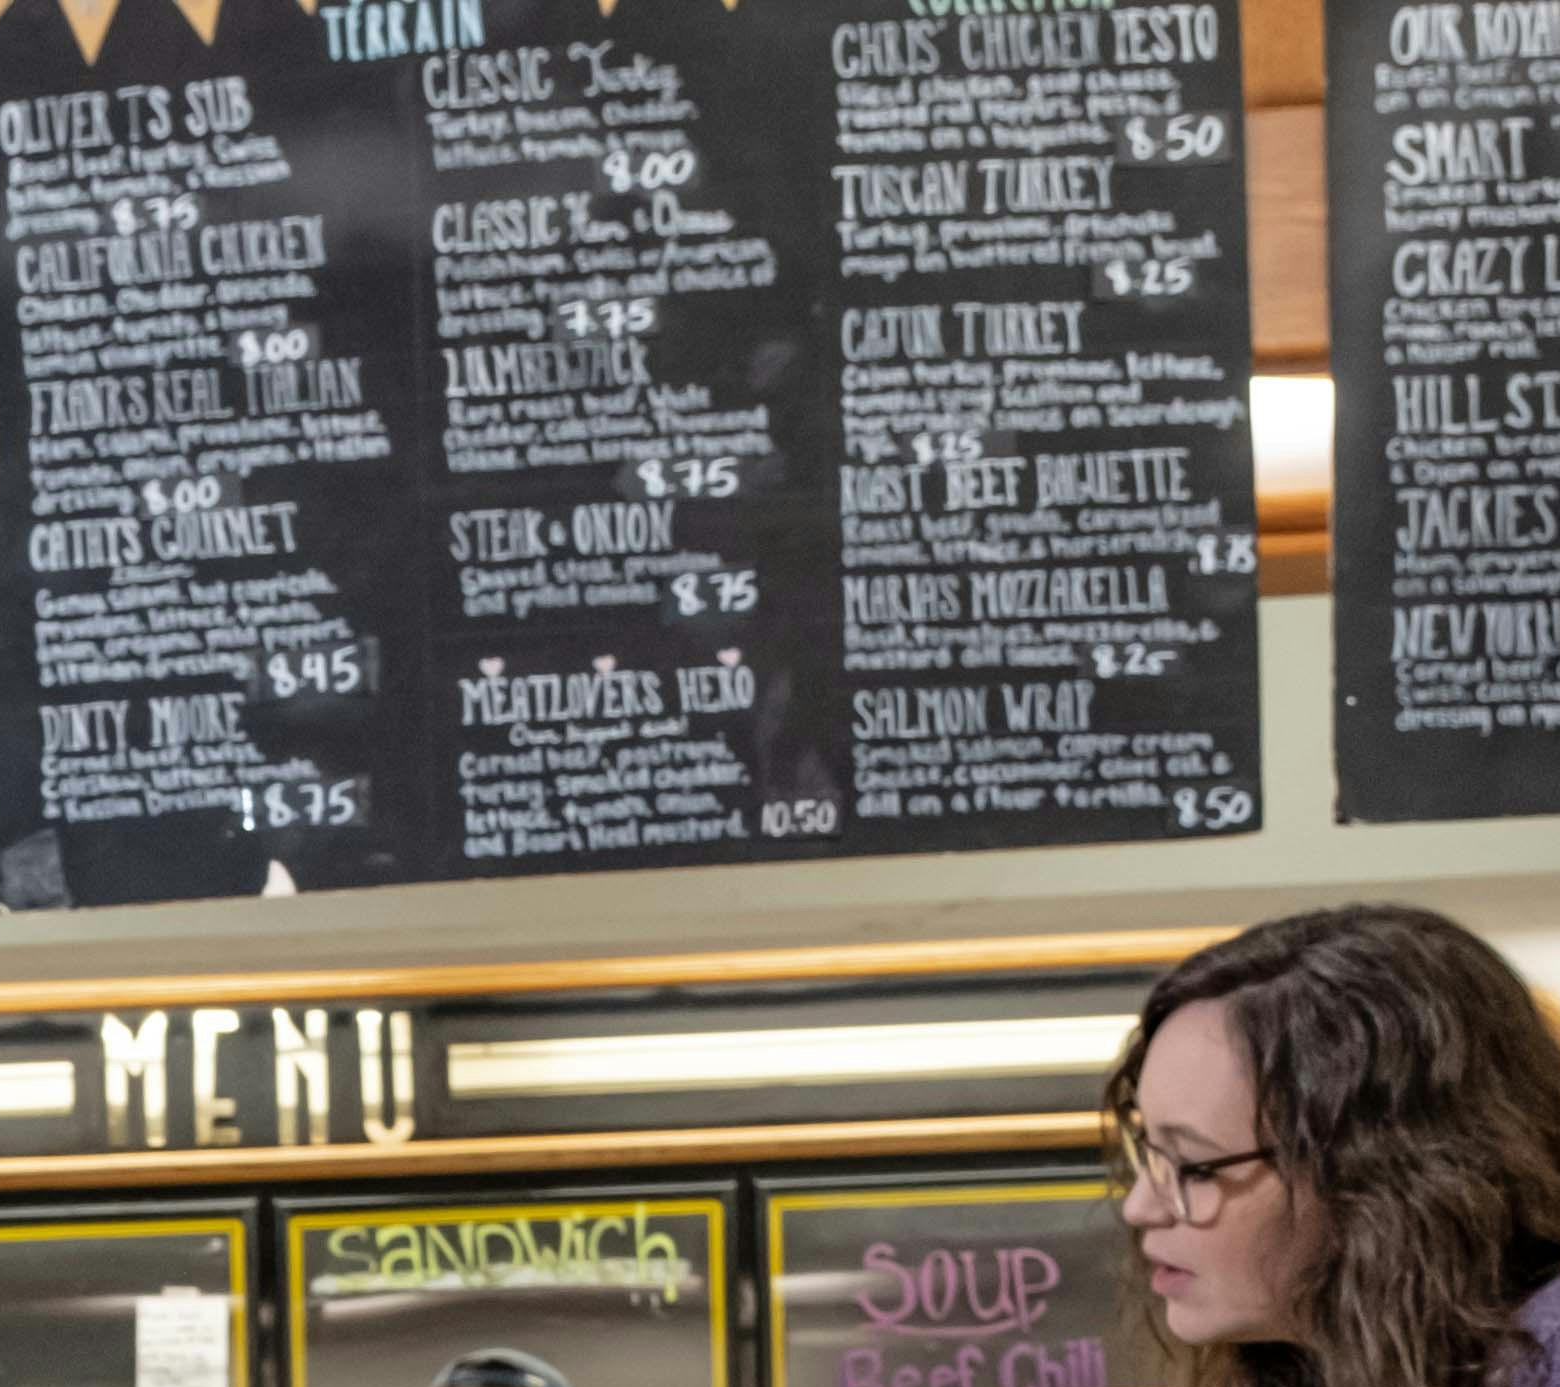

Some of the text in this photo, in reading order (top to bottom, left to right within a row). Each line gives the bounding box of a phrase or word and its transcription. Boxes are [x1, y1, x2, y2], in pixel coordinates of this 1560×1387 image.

[959, 5, 1219, 72] CHICKEN PESTO
[1389, 6, 1466, 66] OUR
[184, 76, 254, 137] SUB
[421, 46, 555, 110] CLASSIC
[1385, 118, 1534, 186] SMART
[830, 156, 1115, 220] TUSCAN TURKEY
[17, 214, 327, 294] CALIFORNIA CHICKEN
[432, 195, 561, 256] CLASSIC
[1393, 235, 1535, 298] CRAZY
[840, 300, 1086, 363] CAJUN TURKEY
[442, 337, 651, 398] LUMBERJACK
[1392, 373, 1499, 436] HILL
[637, 456, 740, 498] 8.75
[839, 464, 923, 515] ROAST
[449, 500, 676, 562] STEAK ONION
[970, 565, 1170, 620] MOZZARELLA
[1390, 603, 1479, 661] NEW
[266, 645, 361, 699] 8.45
[458, 666, 755, 726] MEATLOVERS HERO
[148, 692, 248, 748] MOORE
[851, 678, 1095, 740] SALMON WRAP
[99, 1009, 418, 1147] MENU
[857, 1242, 1063, 1336] SOUP
